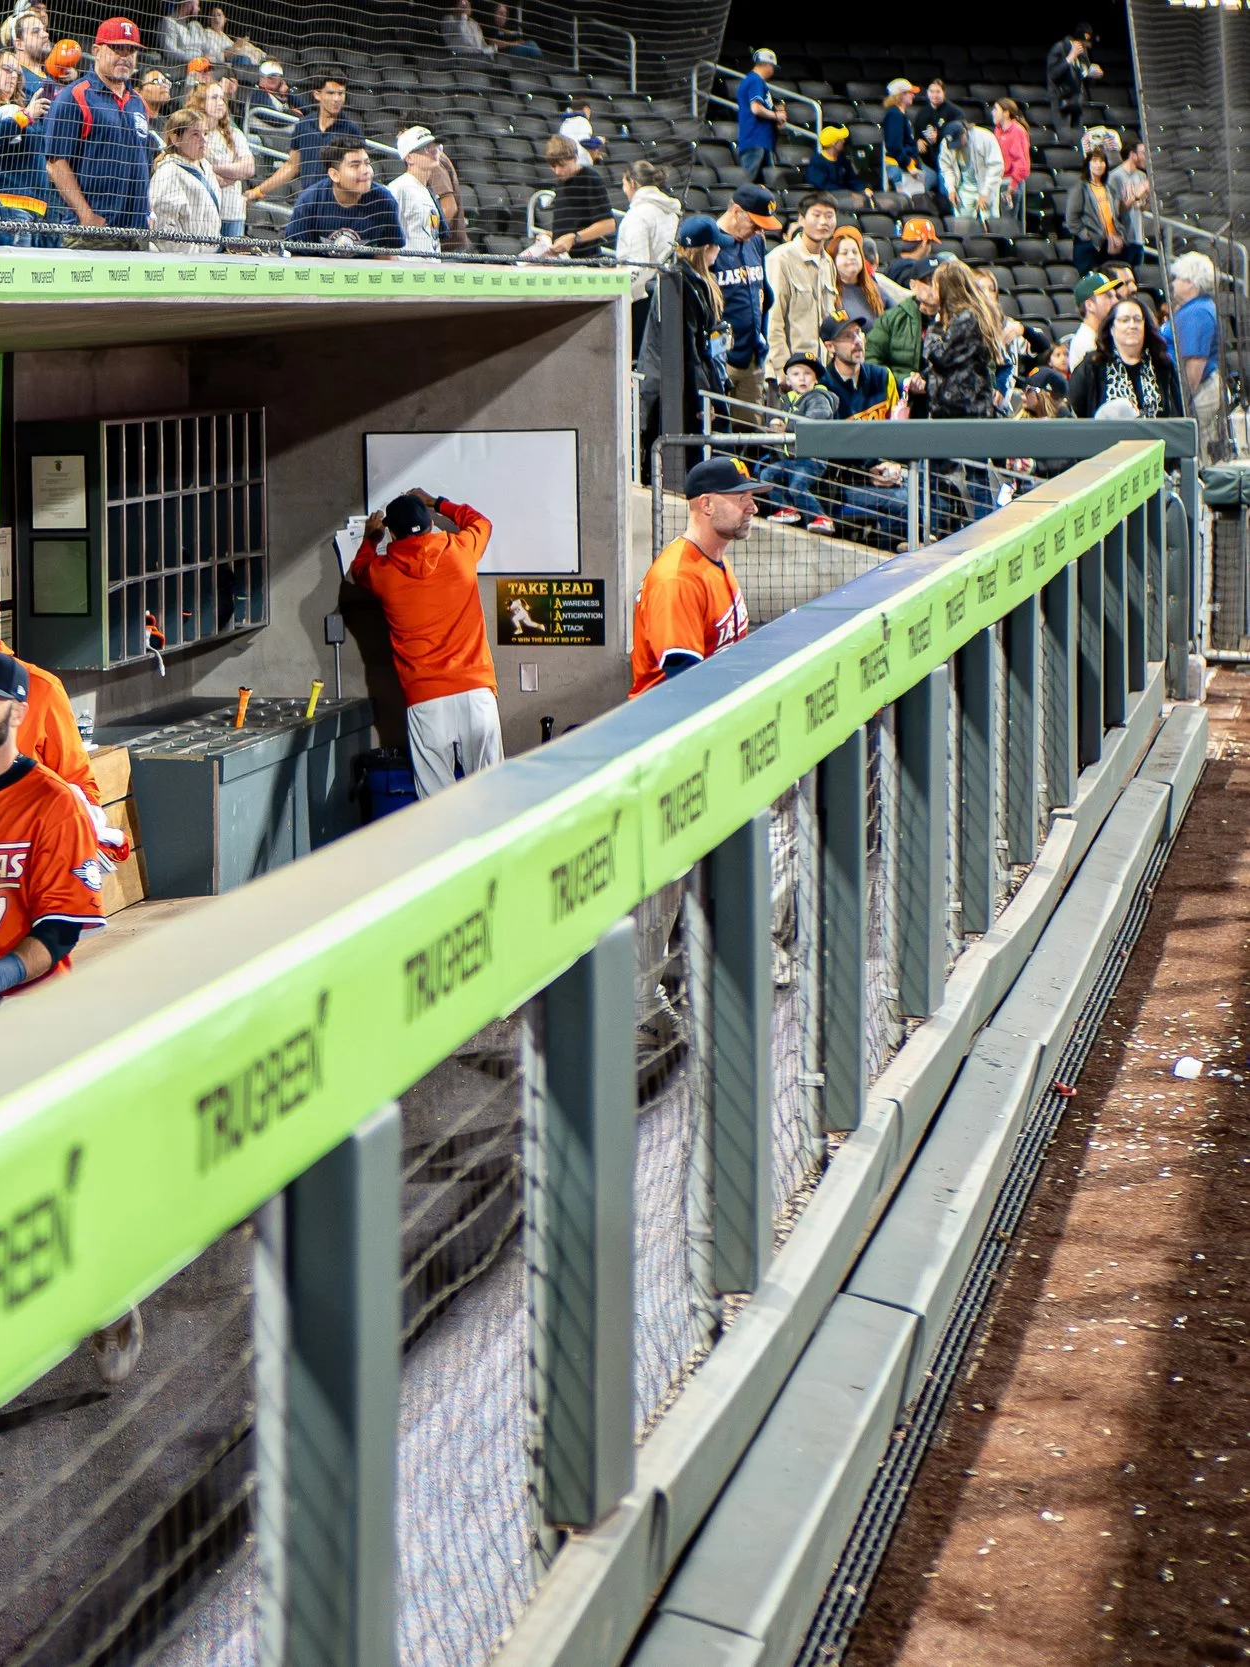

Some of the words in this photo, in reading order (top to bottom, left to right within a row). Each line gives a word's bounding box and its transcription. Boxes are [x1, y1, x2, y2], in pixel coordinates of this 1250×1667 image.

[121, 23, 132, 35] T
[508, 583, 548, 595] TAKE
[553, 583, 593, 595] LEAD
[554, 598, 600, 609] AWARENESS
[554, 610, 603, 621] ANTICIPATION
[554, 623, 584, 634] ATTACK
[196, 1028, 323, 1176] TRUGREEN
[405, 909, 492, 1023] TRUGREEN
[552, 833, 616, 924] TRUGREEN
